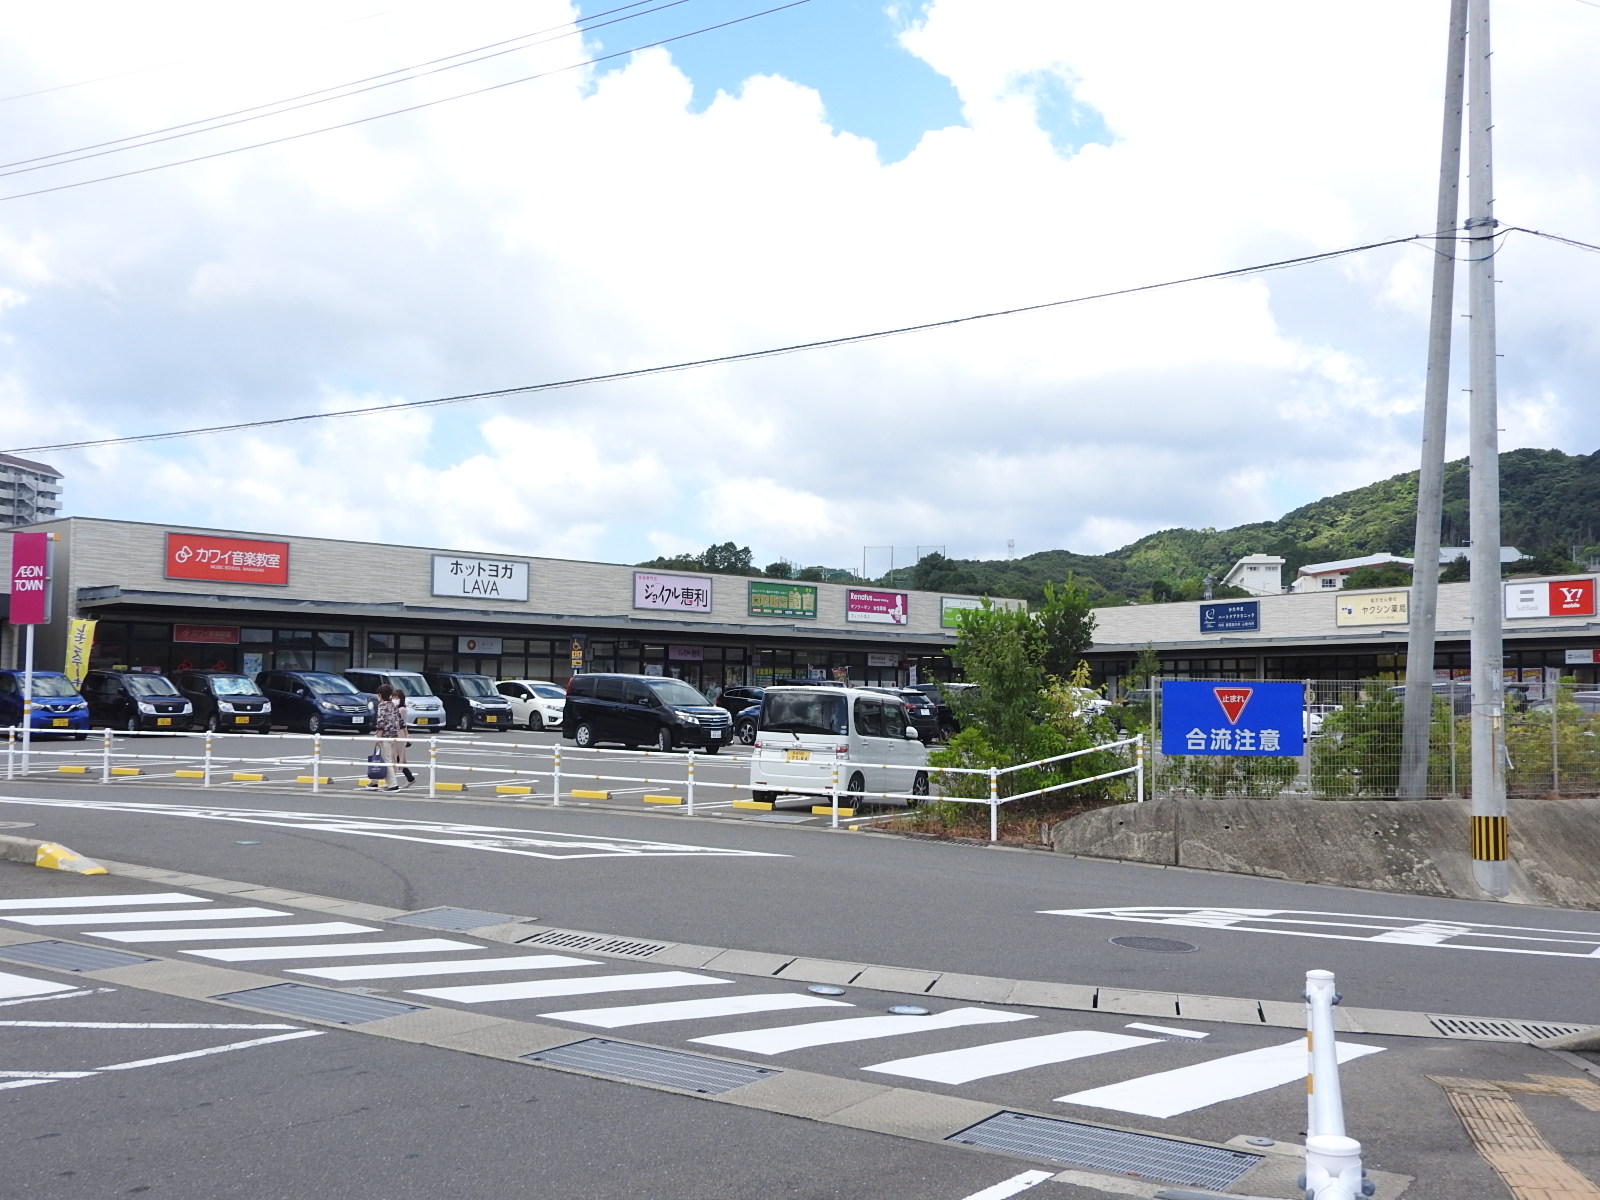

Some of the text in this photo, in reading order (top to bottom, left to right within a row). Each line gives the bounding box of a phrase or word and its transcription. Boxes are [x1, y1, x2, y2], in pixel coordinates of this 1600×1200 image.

[195, 548, 280, 568] カワイ音楽教室
[450, 560, 515, 580] ホットヨガ
[14, 579, 44, 591] TOWN
[462, 578, 500, 596] LAVA
[644, 584, 708, 608] ジョイフル恵利
[850, 592, 873, 602] Renatus
[1559, 587, 1583, 603] Y!
[1362, 604, 1406, 615] ヤクシン薬局
[1222, 695, 1245, 703] 止まれ
[1185, 727, 1281, 751] 合流注意
